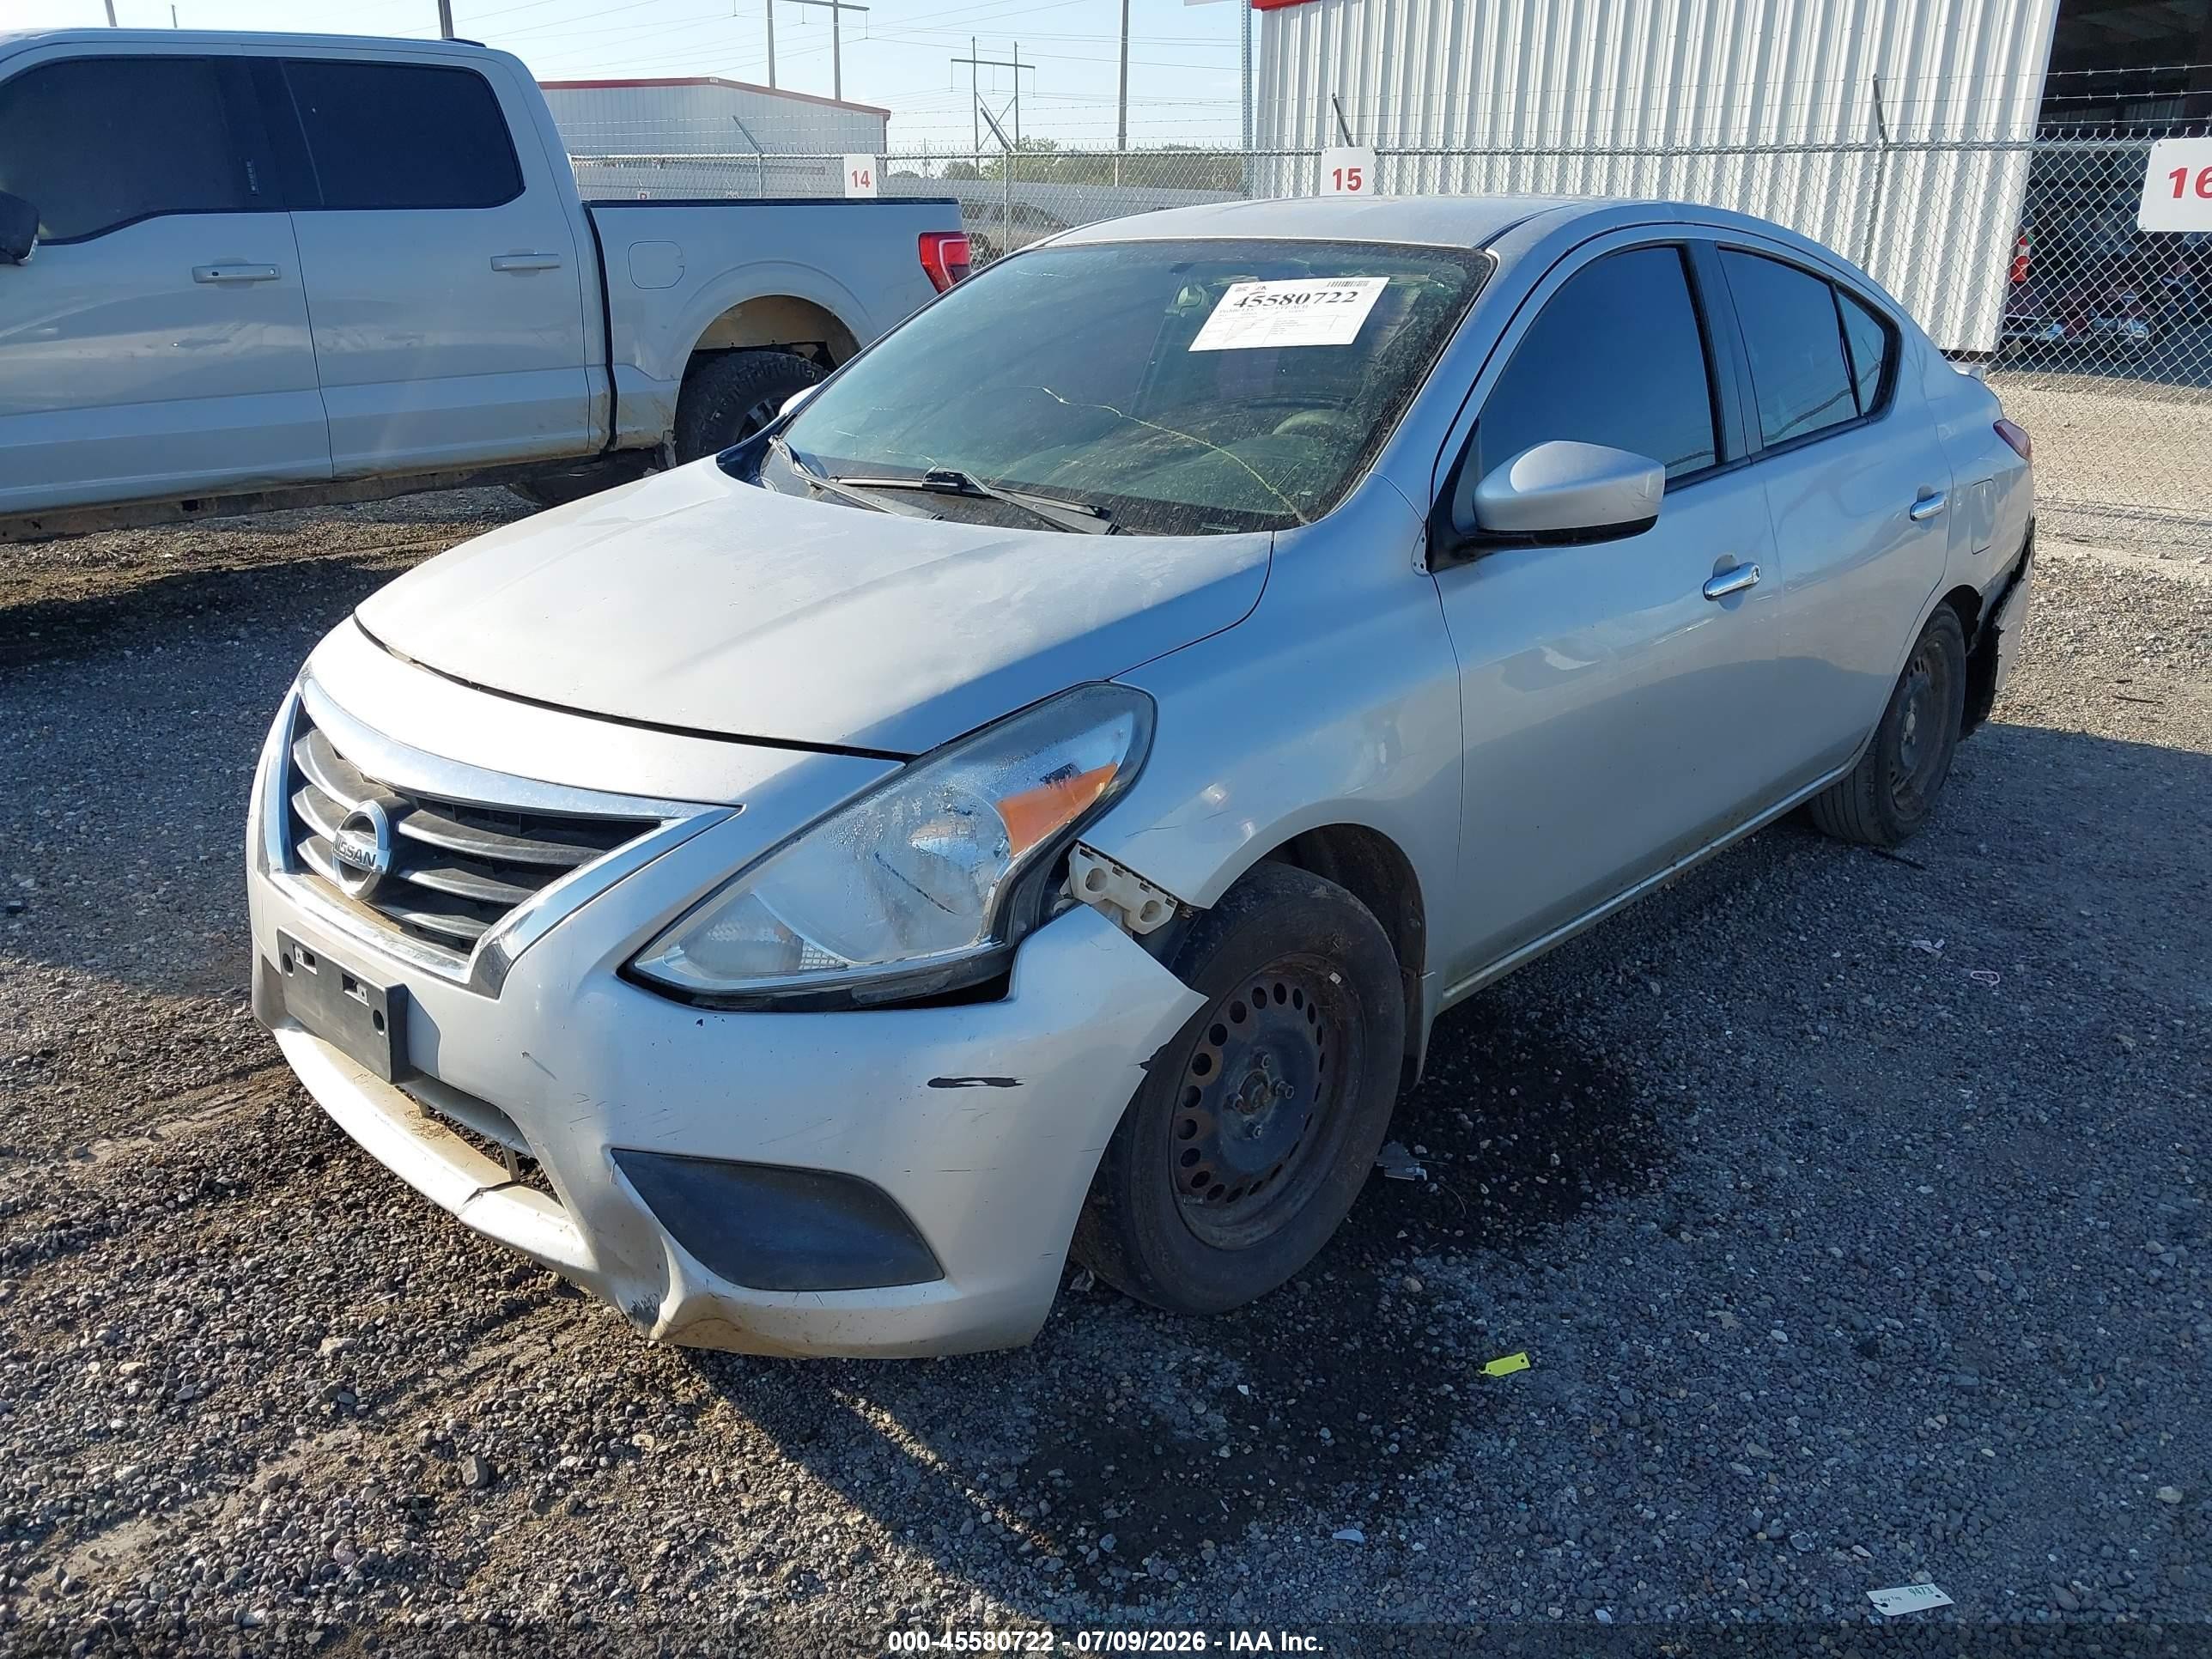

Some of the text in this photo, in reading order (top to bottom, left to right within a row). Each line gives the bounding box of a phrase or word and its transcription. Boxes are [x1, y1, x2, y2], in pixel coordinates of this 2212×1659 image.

[851, 170, 871, 188] 14
[1332, 167, 1362, 191] 15
[2168, 166, 2212, 199] 16
[1233, 291, 1358, 308] 45580722
[333, 836, 377, 867] NISSAN
